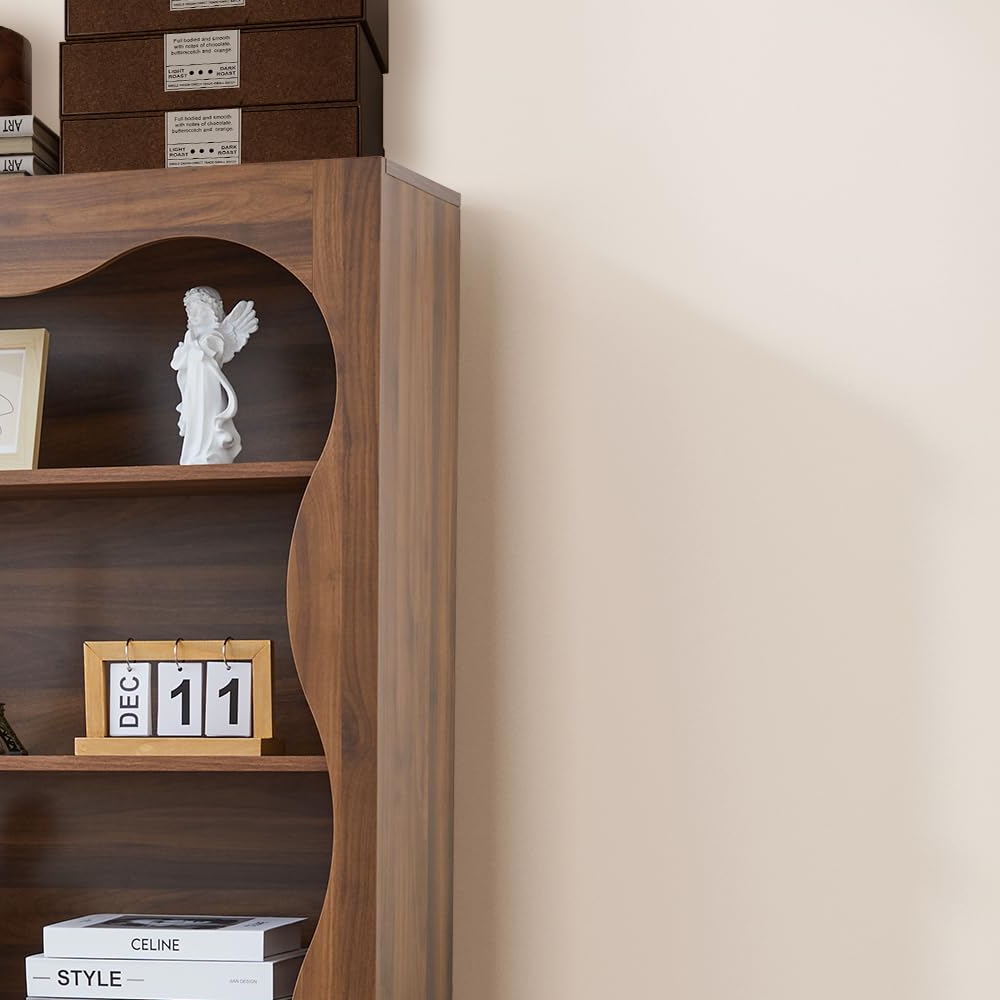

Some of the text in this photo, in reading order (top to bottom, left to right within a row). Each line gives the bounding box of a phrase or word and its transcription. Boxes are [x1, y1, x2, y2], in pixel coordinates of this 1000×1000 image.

[3, 119, 23, 132] ART
[3, 159, 23, 172] ART
[120, 676, 239, 727] DEC 1 1
[131, 938, 180, 951] CELINE
[57, 970, 122, 987] STYLE
